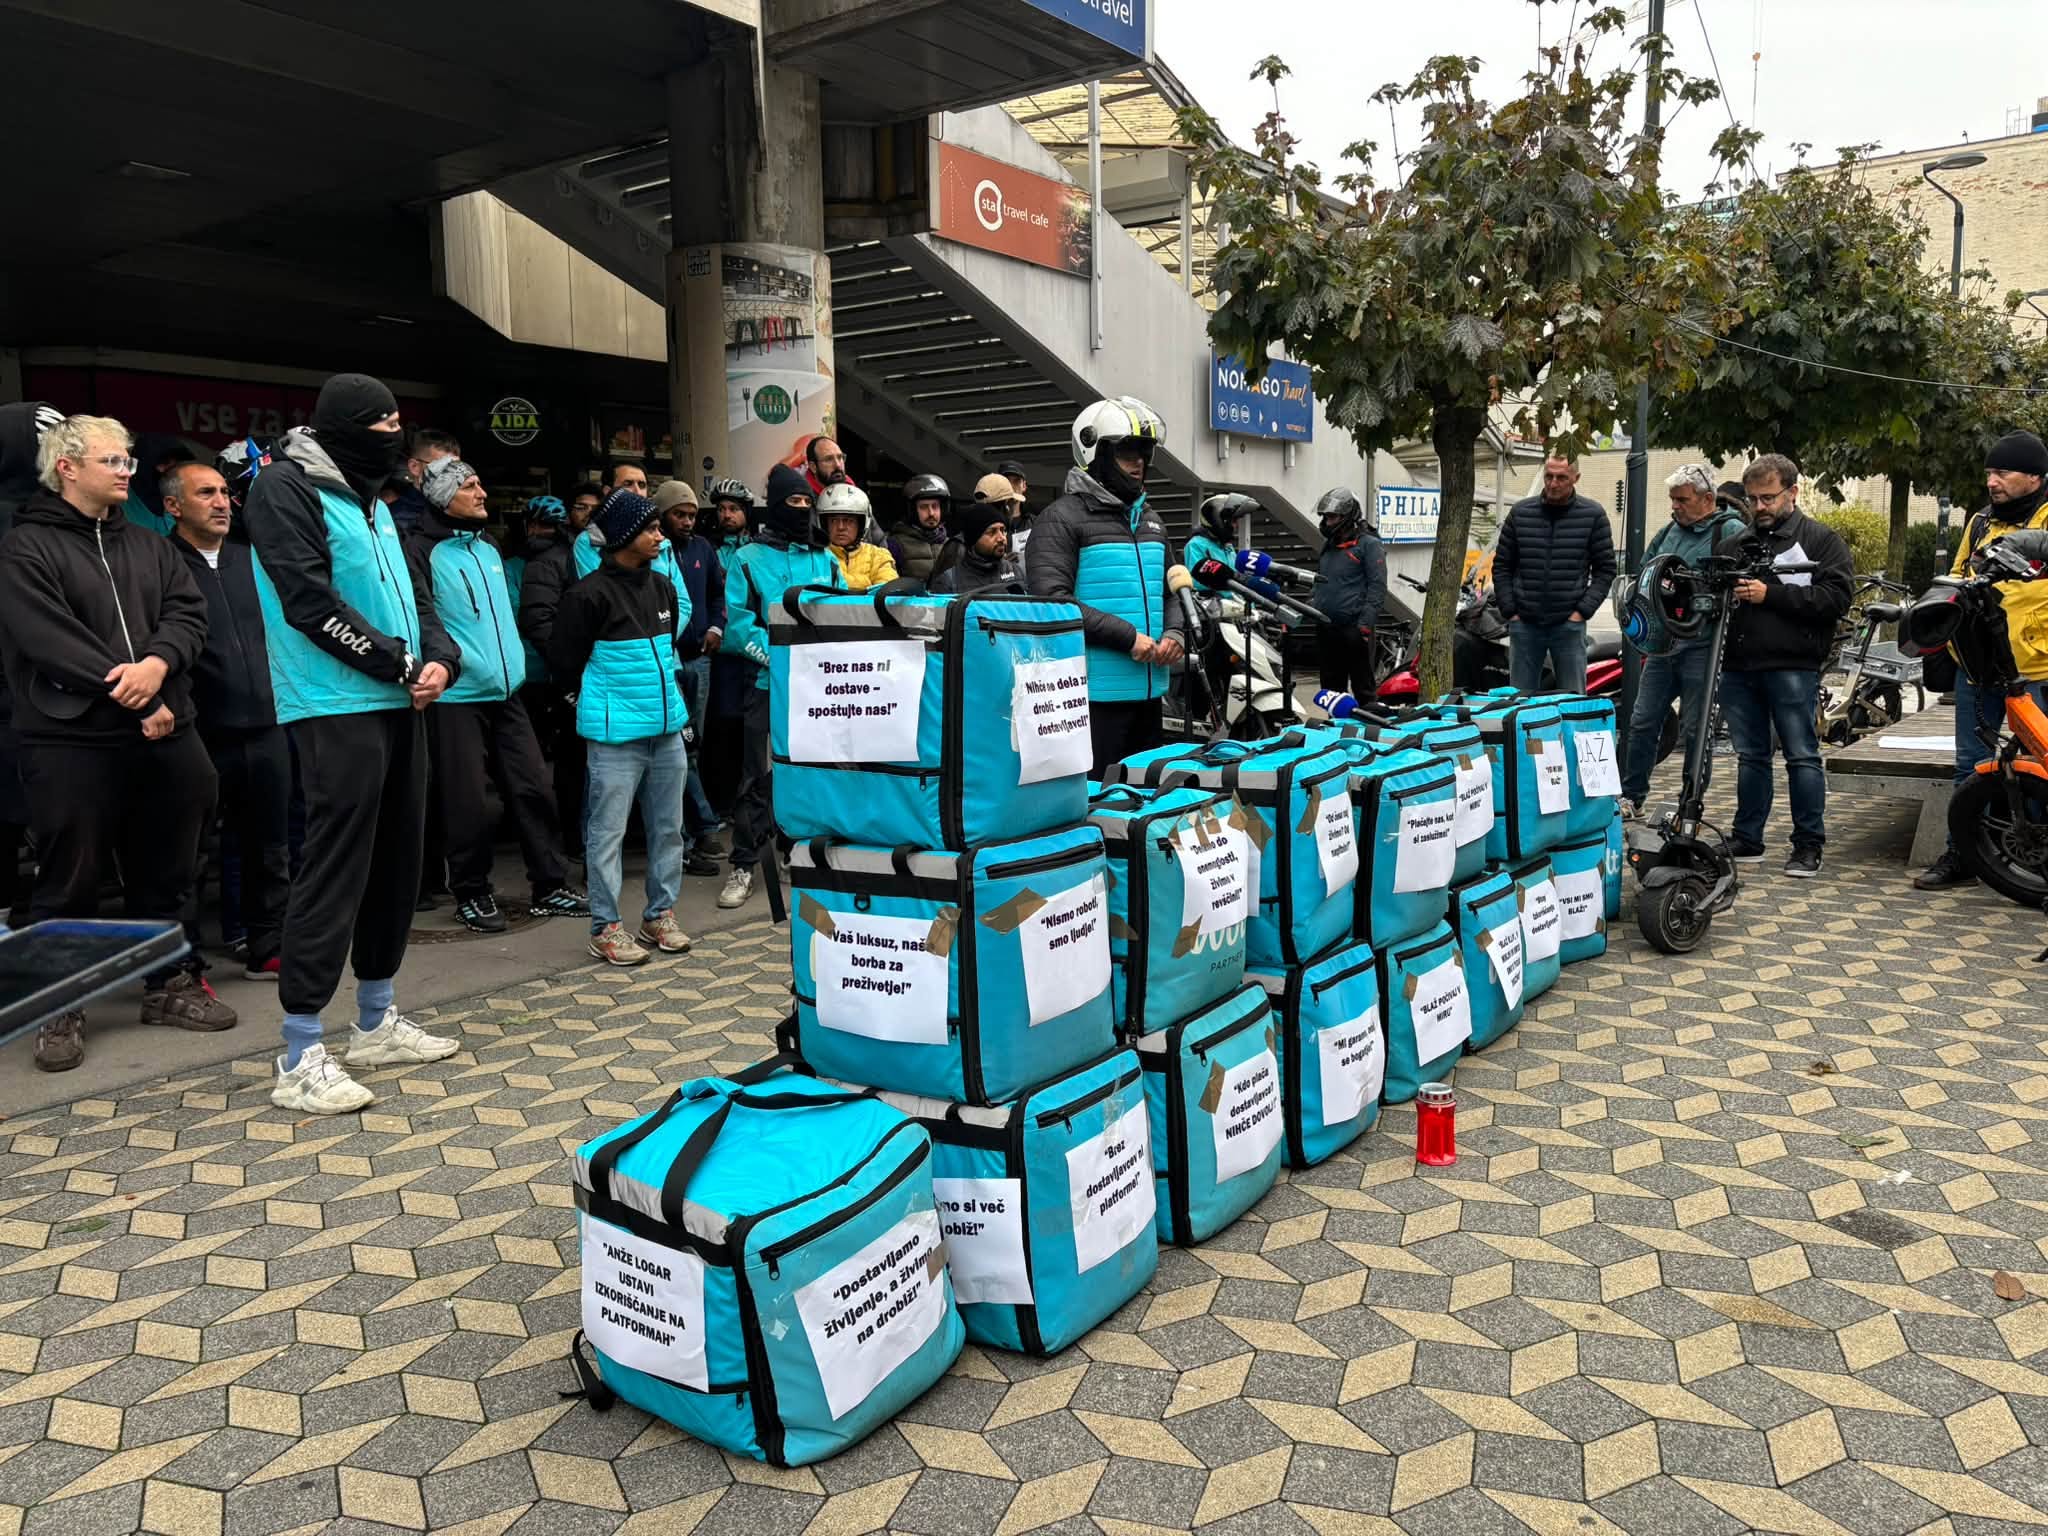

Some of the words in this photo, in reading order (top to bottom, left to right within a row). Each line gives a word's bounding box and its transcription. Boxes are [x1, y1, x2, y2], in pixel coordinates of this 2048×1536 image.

[1003, 204, 1028, 222] travel
[1030, 213, 1049, 229] cafe
[322, 616, 373, 655] Wolt
[851, 662, 873, 672] nas
[877, 659, 891, 671] ni
[825, 682, 870, 695] dostave
[1057, 676, 1079, 690] dela
[808, 703, 863, 719] spoštujte
[1063, 697, 1086, 710] razen
[1216, 836, 1228, 847] do
[857, 932, 899, 952] luksuz,
[1049, 934, 1069, 950] smo
[852, 954, 886, 970] borba
[889, 961, 903, 972] za
[1226, 1117, 1251, 1140] NIHČE
[1086, 1153, 1138, 1199] dostavljavcev
[963, 1198, 976, 1213] si
[979, 1198, 1005, 1213] več
[635, 1256, 672, 1281] LOGAR
[619, 1271, 654, 1297] USTAVI
[824, 1291, 888, 1339] življenje,
[889, 1279, 899, 1292] a
[899, 1247, 933, 1285] živimo
[595, 1281, 667, 1323] IZKORIŠČANJE
[669, 1312, 686, 1330] NA
[857, 1325, 874, 1345] na
